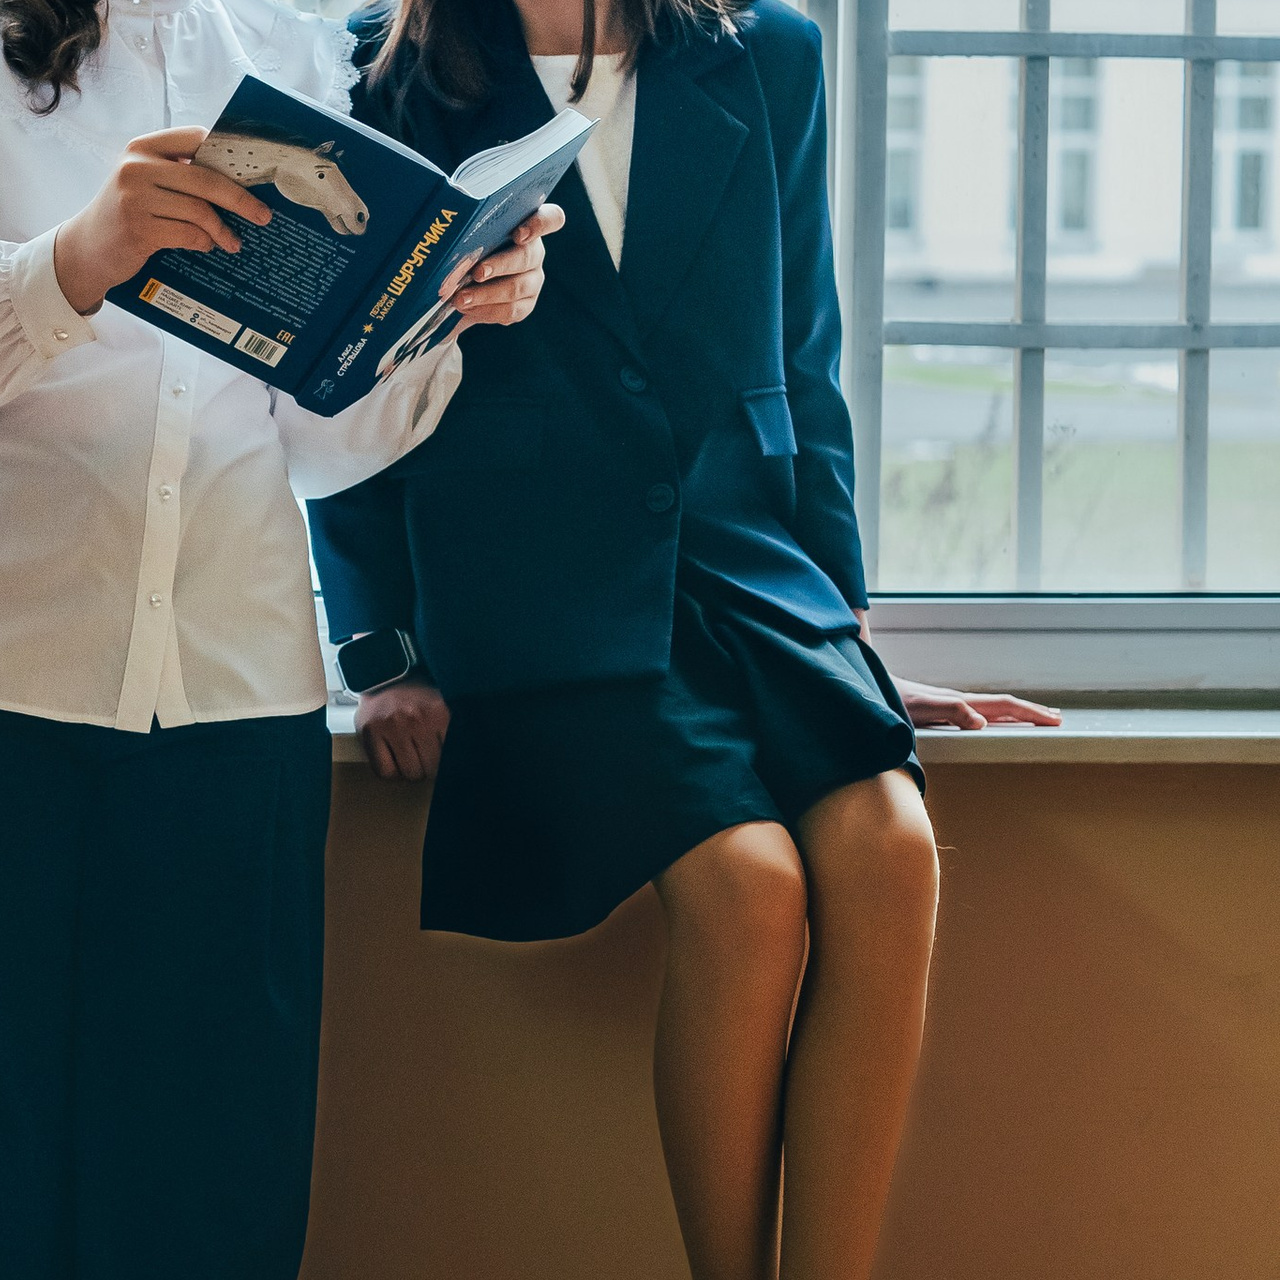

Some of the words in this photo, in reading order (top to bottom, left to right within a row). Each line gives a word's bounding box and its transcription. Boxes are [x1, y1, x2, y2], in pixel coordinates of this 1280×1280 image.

[386, 207, 459, 296] ШУРУПЧИКА
[369, 292, 389, 318] ПЕРВЫЙ
[375, 296, 397, 321] ЗАКОН
[336, 337, 368, 377] СТРЕЛЬЦОВА
[337, 343, 354, 364] Алиса
